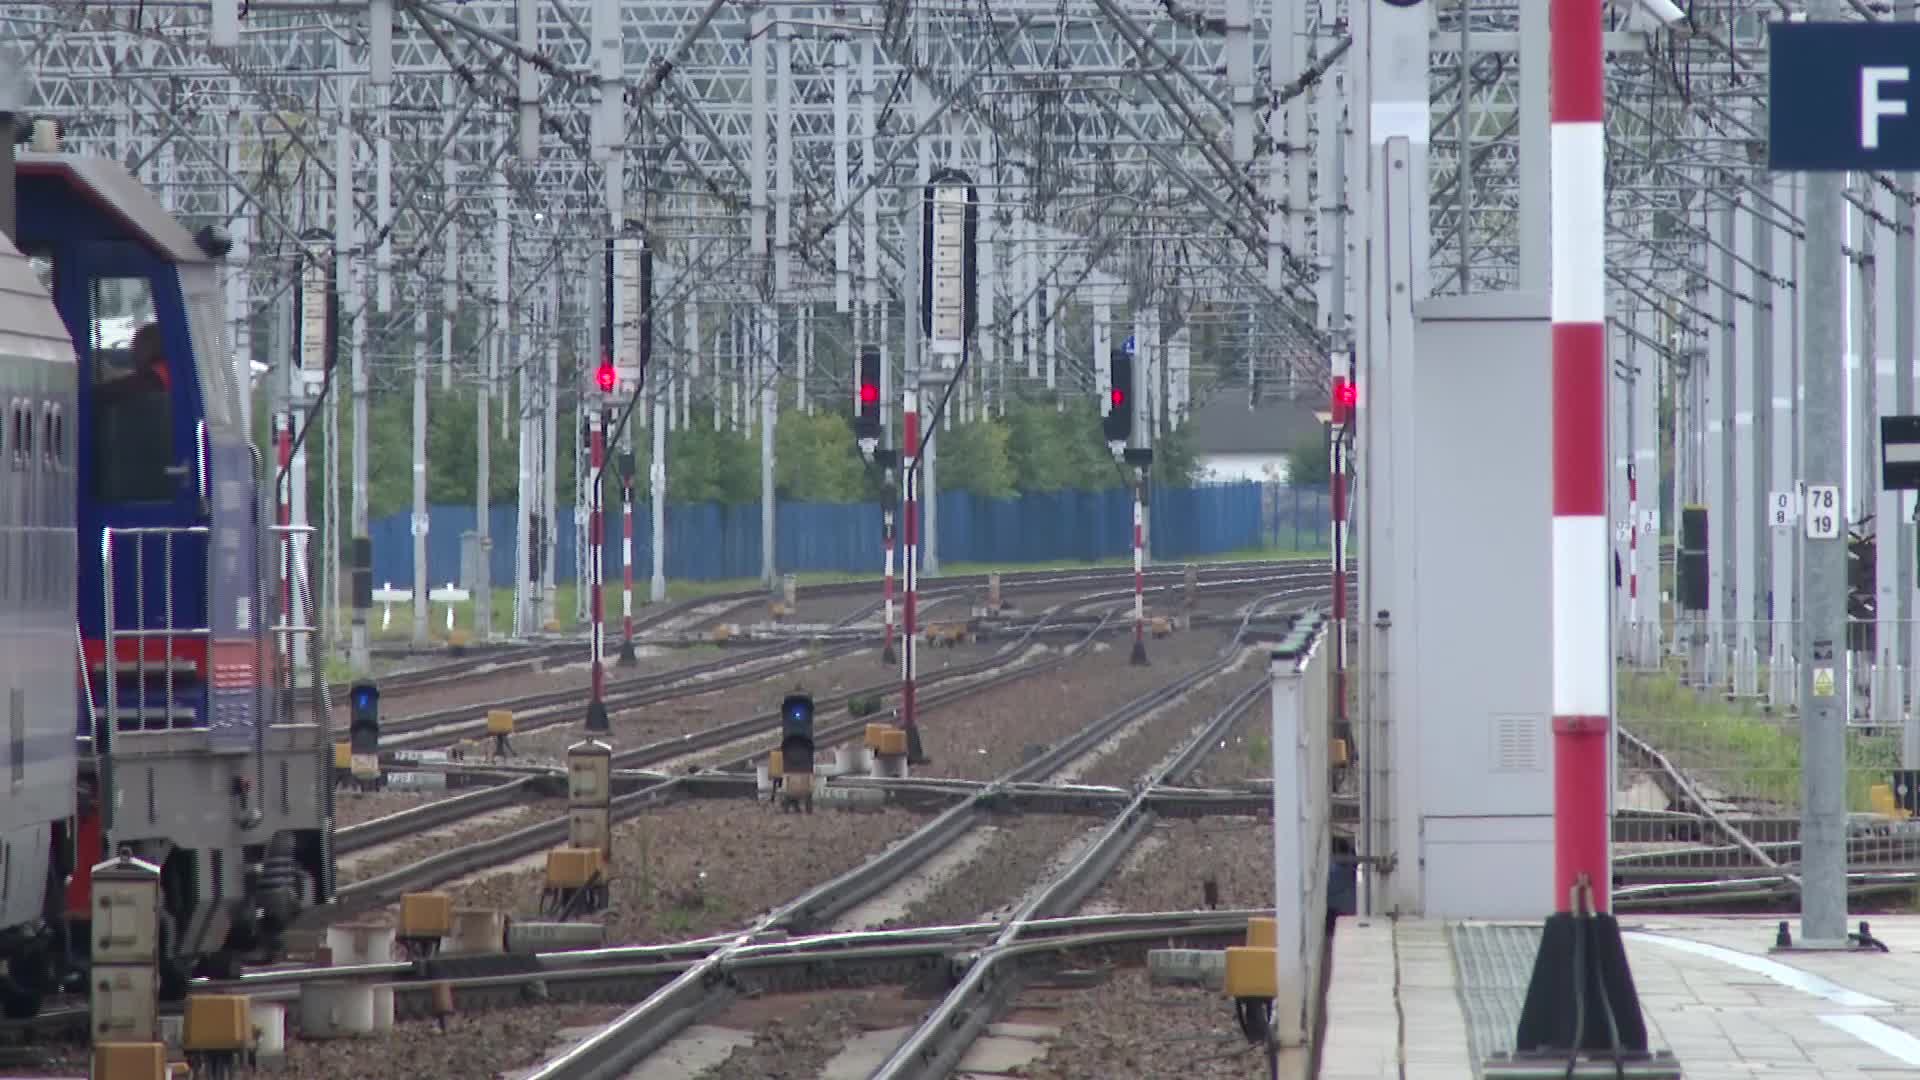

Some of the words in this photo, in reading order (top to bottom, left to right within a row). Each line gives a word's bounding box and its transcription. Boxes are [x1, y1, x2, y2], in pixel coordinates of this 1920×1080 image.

[1861, 66, 1910, 149] F
[1812, 490, 1833, 508] 78
[1813, 515, 1832, 533] 19
